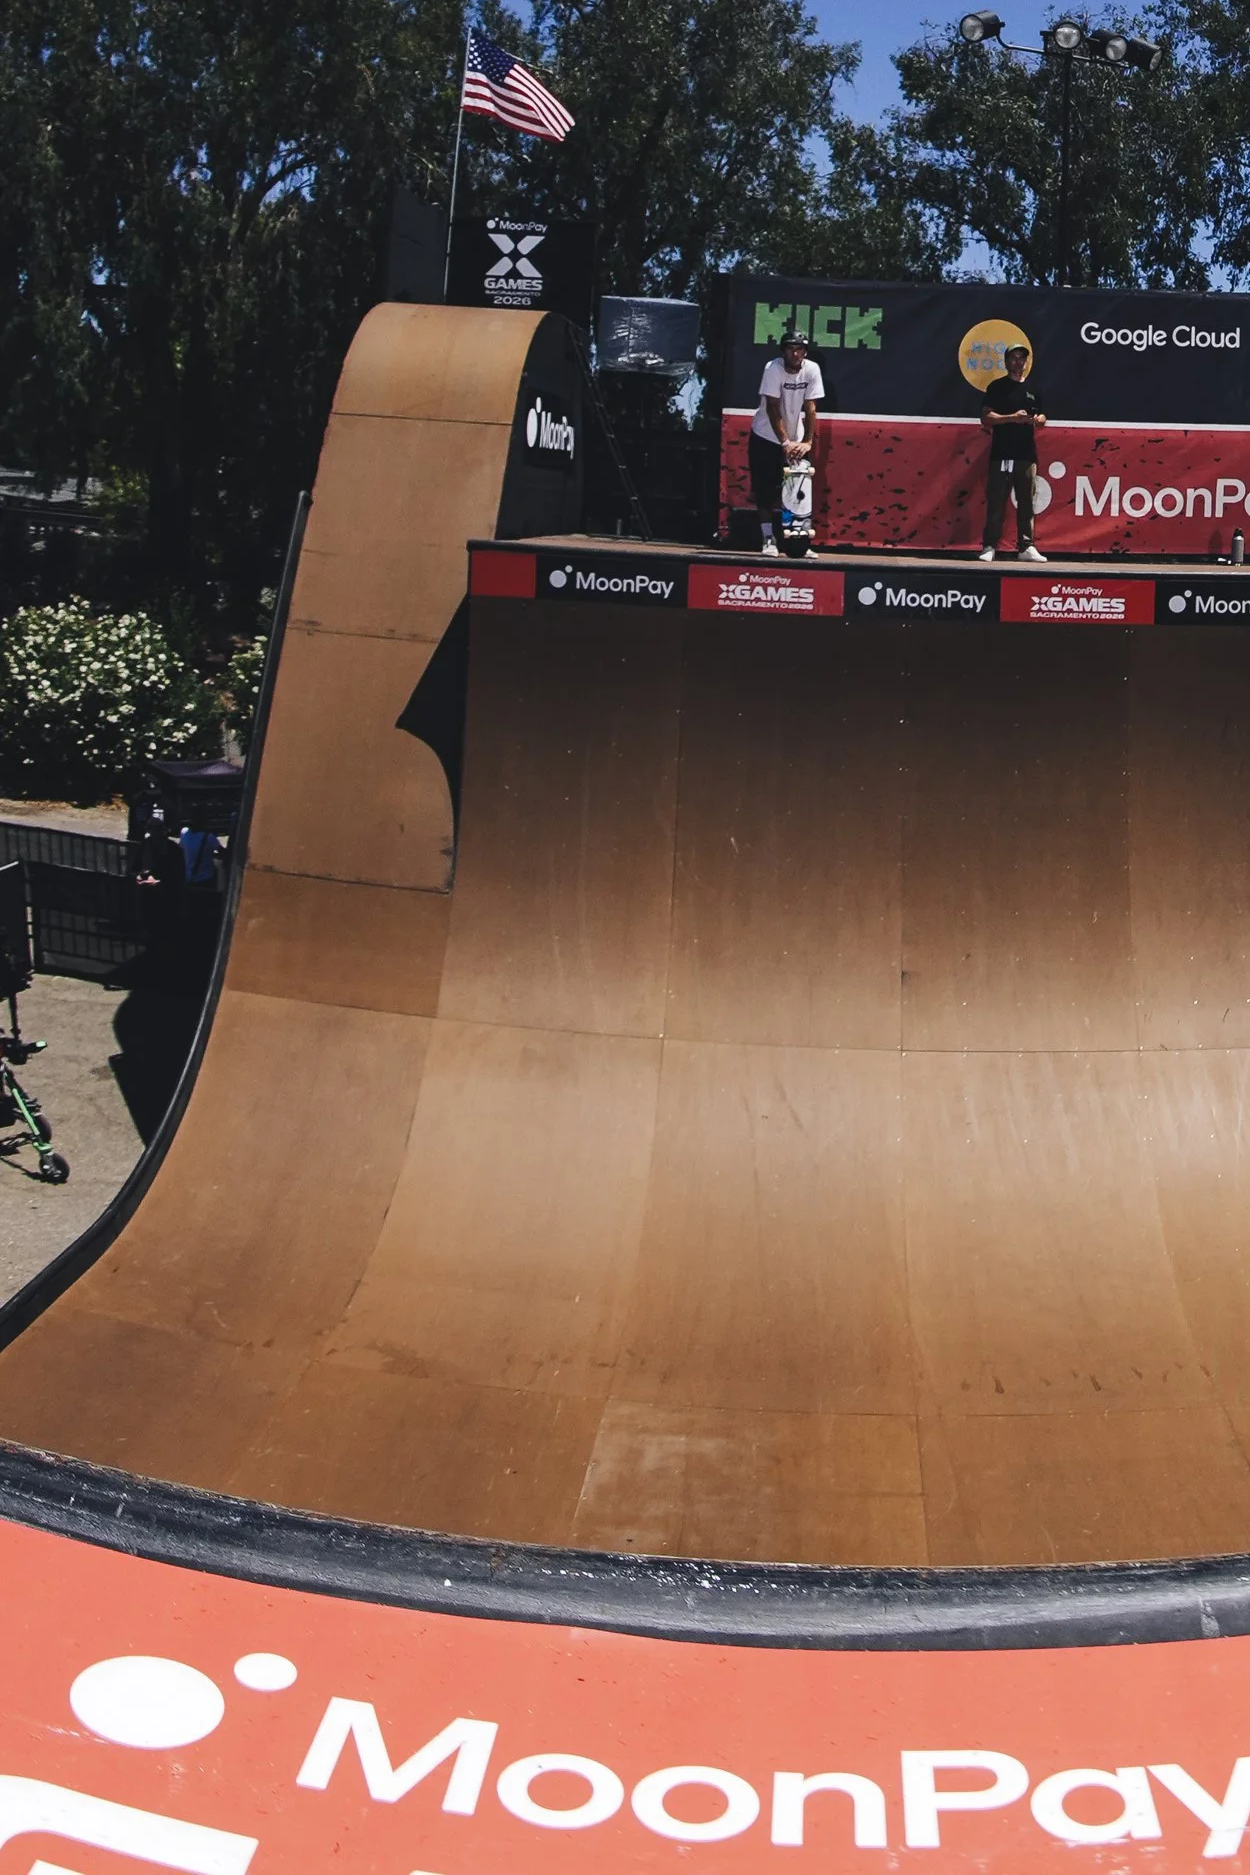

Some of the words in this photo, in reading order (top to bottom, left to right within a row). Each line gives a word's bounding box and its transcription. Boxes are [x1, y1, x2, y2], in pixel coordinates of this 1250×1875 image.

[500, 221, 548, 233] MoonPay
[484, 277, 544, 291] GAMES
[485, 289, 542, 297] SACRAMENTO
[494, 296, 531, 306] 2026
[753, 302, 883, 350] KICK
[1080, 321, 1168, 351] Google
[1172, 325, 1241, 348] Cloud
[576, 571, 675, 599] MoonPay
[749, 574, 791, 586] MoonPay
[1062, 586, 1103, 596] MoonPay
[886, 588, 986, 612] MoonPay
